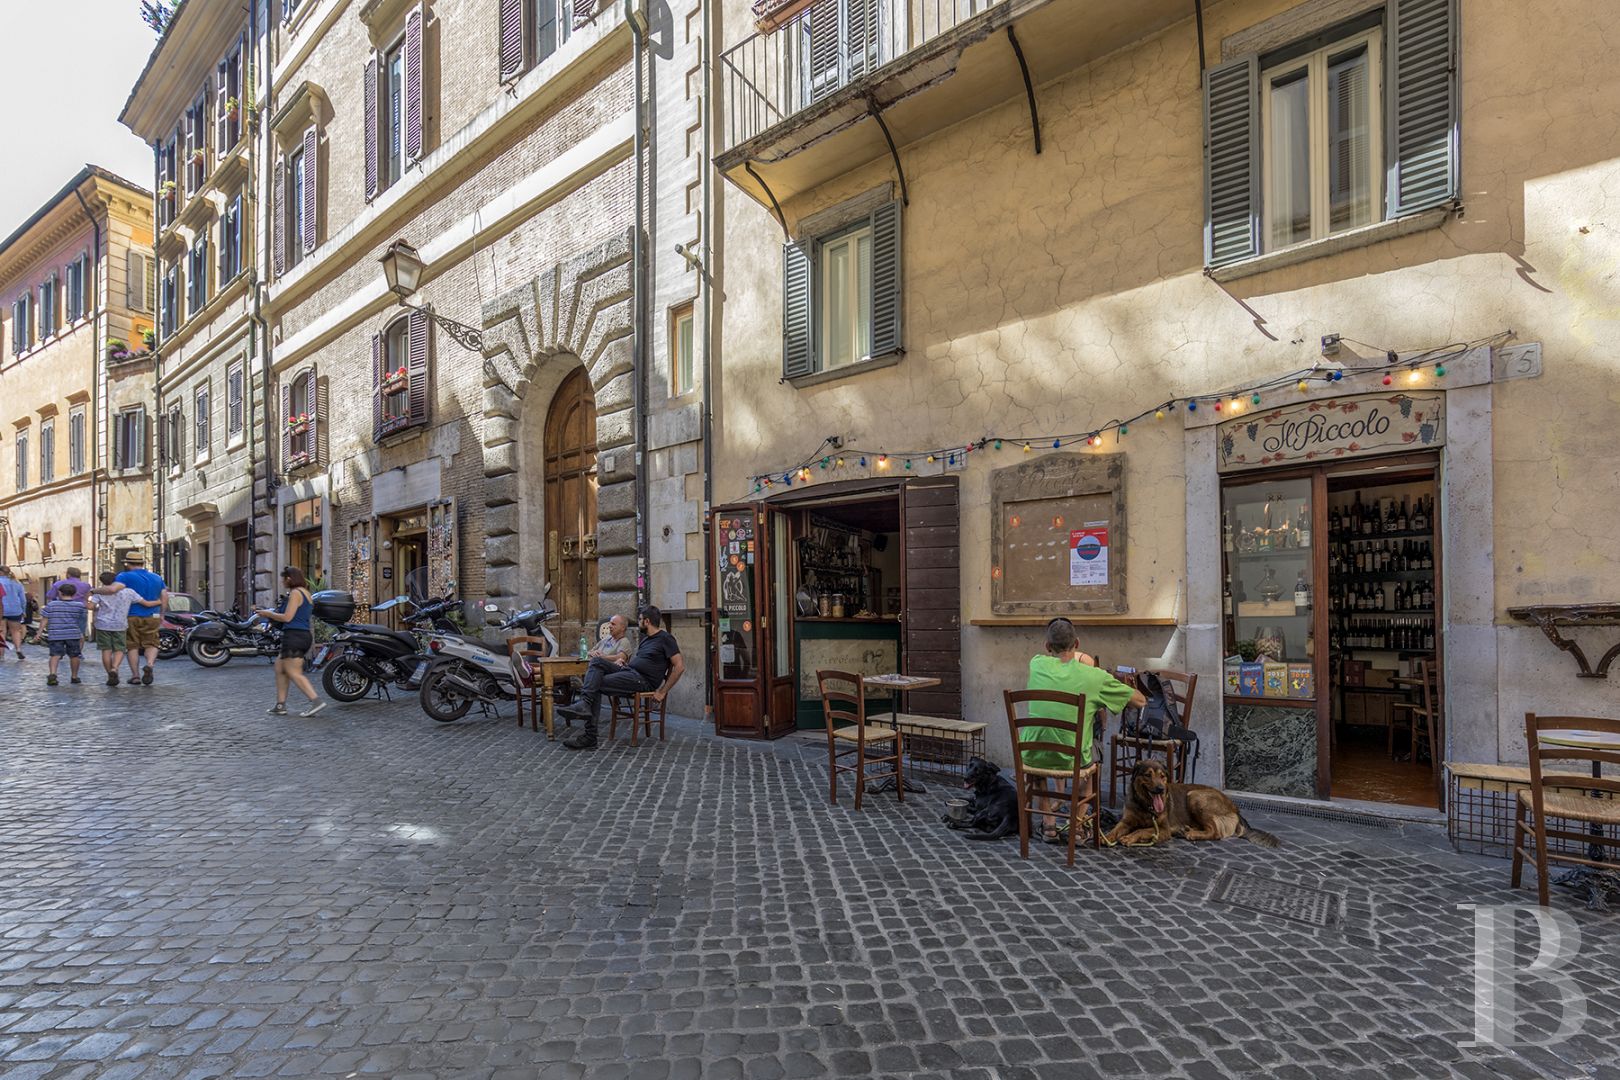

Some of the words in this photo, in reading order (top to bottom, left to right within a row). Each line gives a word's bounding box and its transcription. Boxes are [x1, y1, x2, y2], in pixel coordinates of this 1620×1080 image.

[1498, 349, 1536, 376] 75
[1262, 418, 1296, 453] Il
[1292, 407, 1391, 452] Piccolo
